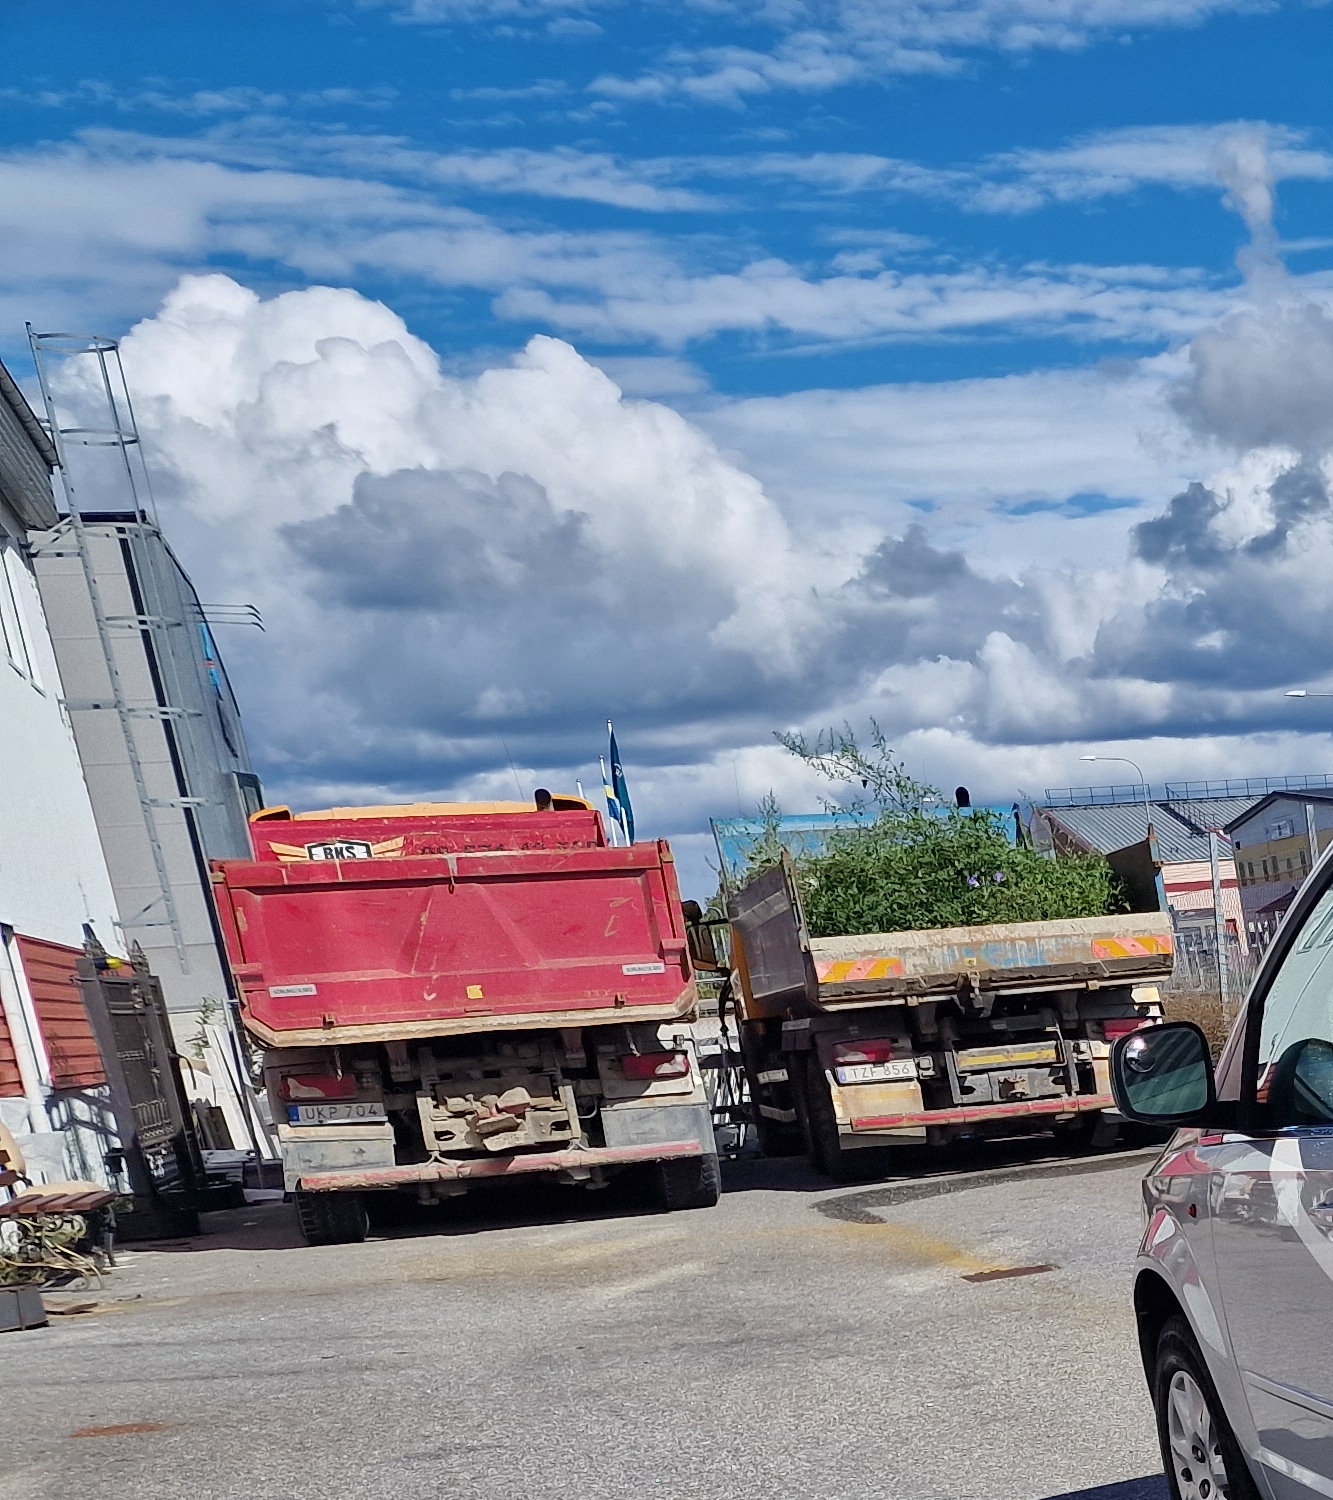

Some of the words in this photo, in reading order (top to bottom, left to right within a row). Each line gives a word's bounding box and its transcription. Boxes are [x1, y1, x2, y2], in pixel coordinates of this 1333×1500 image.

[851, 1066, 878, 1079] TZF
[883, 1063, 910, 1076] 856
[304, 1106, 338, 1120] UKP
[344, 1104, 378, 1118] 704
